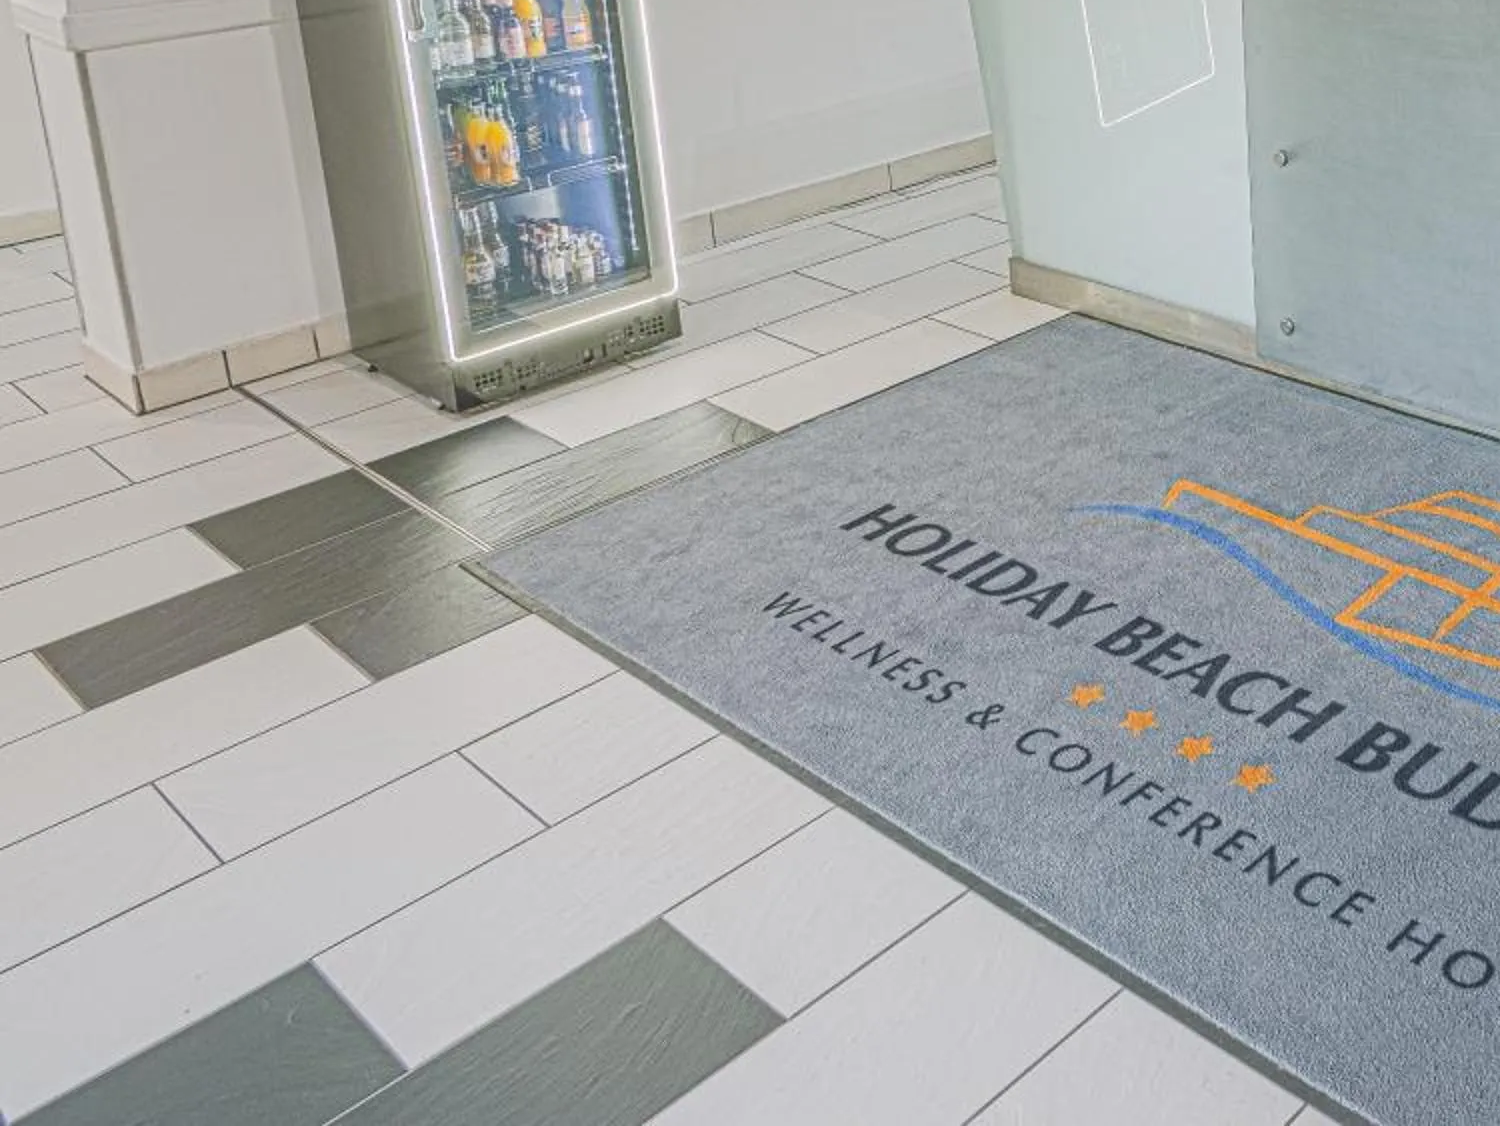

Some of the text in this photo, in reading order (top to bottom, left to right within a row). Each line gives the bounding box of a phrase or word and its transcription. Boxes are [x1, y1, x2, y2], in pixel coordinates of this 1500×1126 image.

[761, 590, 967, 705] WELLNESS
[964, 702, 1006, 731] &
[1014, 727, 1376, 927] CONFERENCE
[838, 502, 1119, 631] HOLIDAY
[1093, 614, 1347, 744] BEACH
